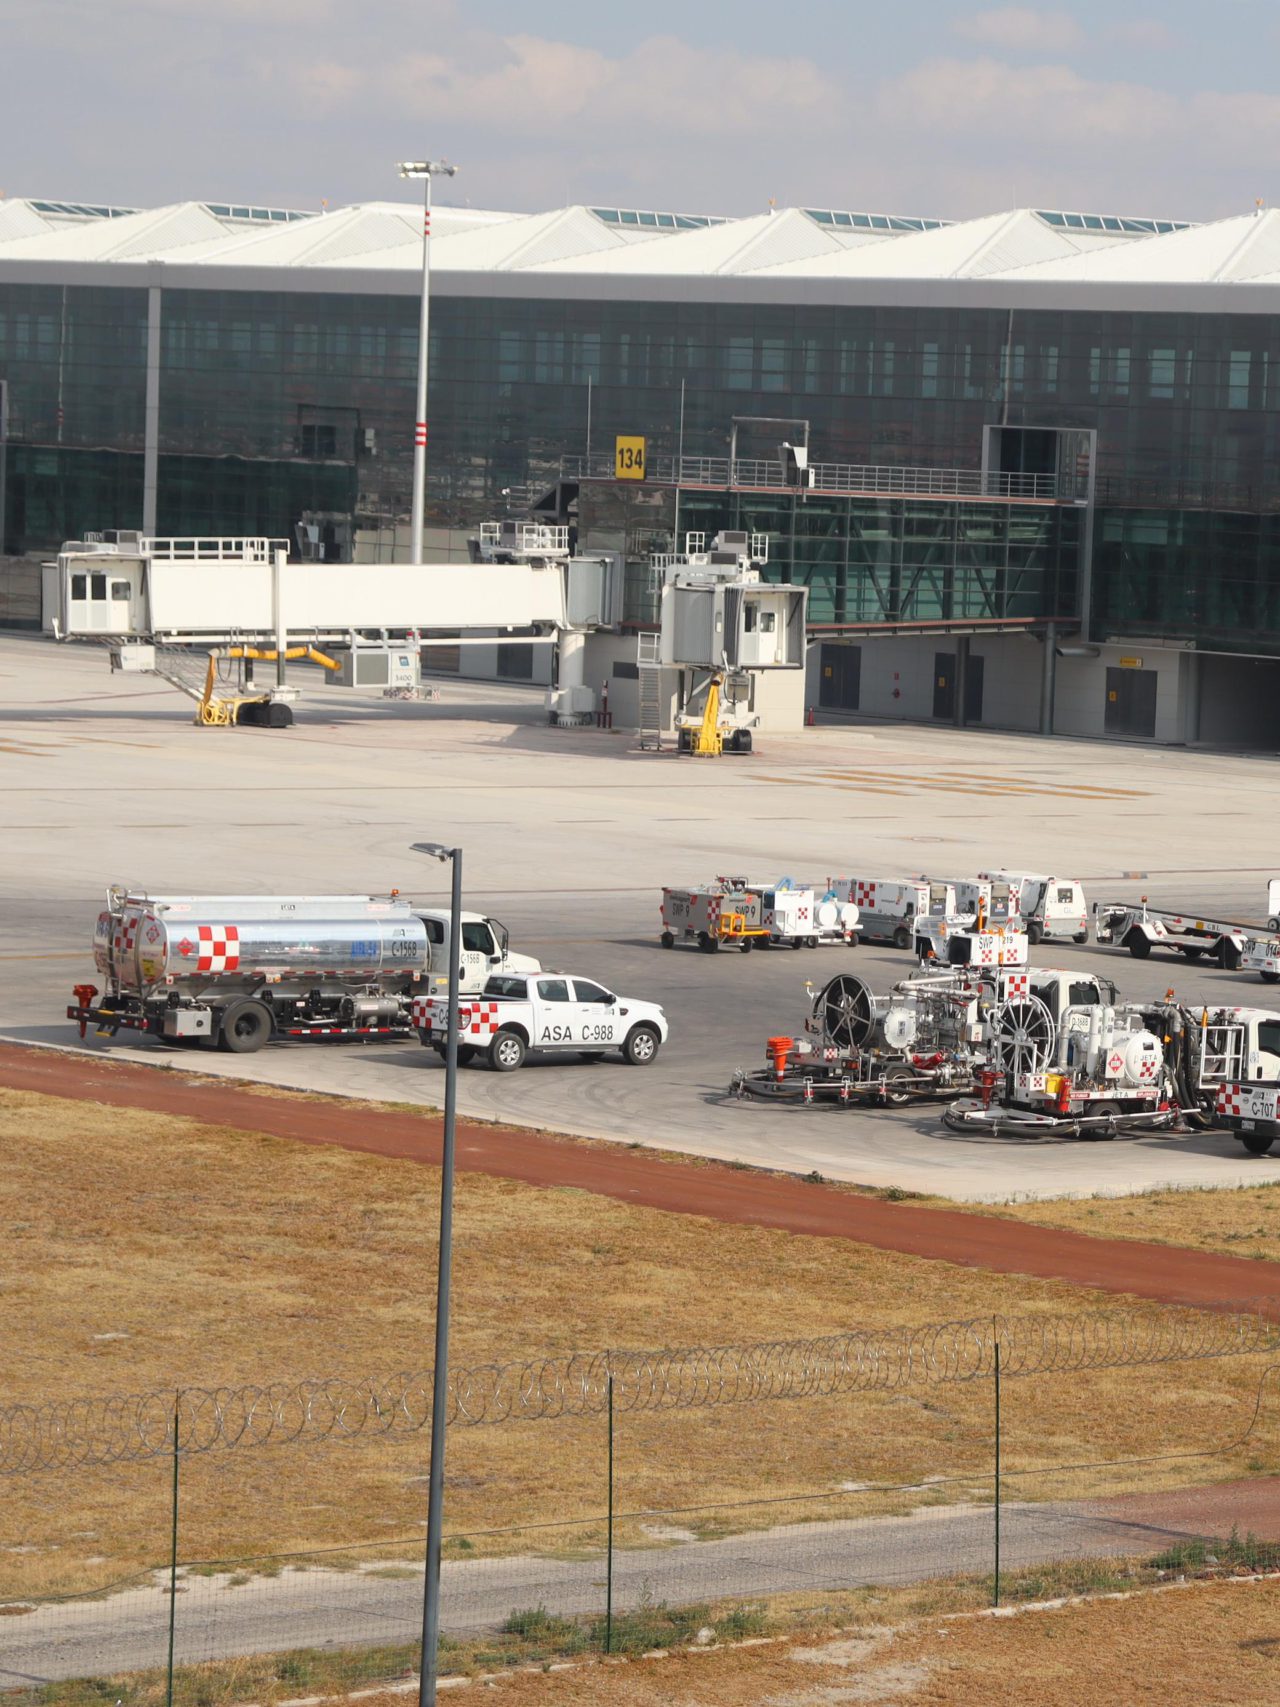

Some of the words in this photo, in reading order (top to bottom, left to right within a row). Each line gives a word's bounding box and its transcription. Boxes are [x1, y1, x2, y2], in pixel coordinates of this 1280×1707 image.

[618, 447, 643, 469] 134
[672, 902, 685, 917] SWP
[685, 902, 691, 917] 9
[751, 905, 756, 918] 9
[979, 936, 994, 950] SWP
[1002, 936, 1014, 945] 219
[541, 1026, 573, 1041] ASA
[581, 1025, 614, 1040] C-988
[1111, 1090, 1122, 1099] JET
[1123, 1090, 1129, 1098] A
[1251, 1101, 1275, 1117] C-707
